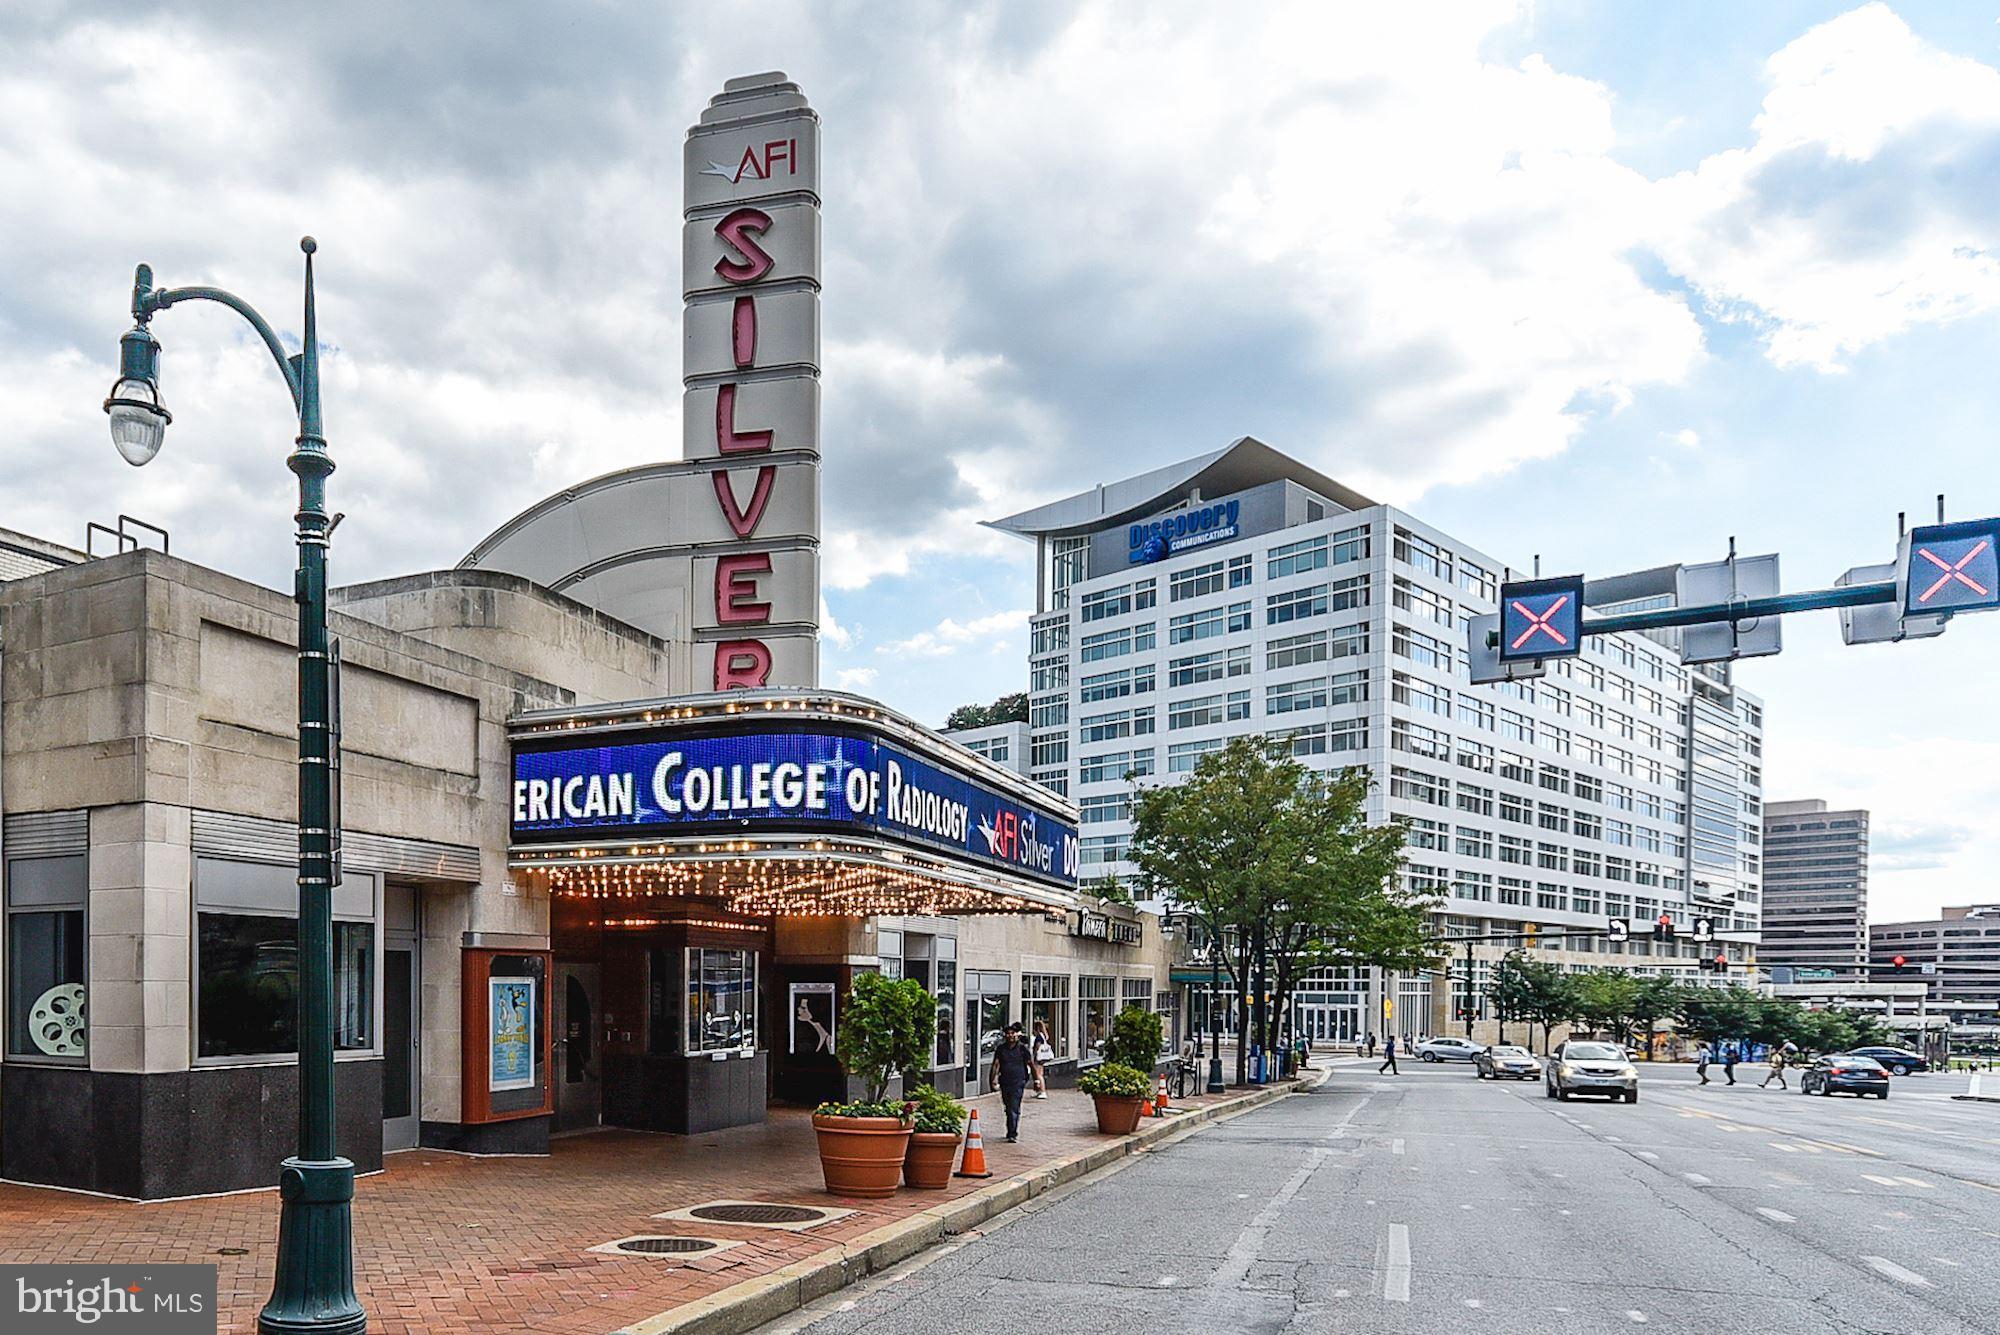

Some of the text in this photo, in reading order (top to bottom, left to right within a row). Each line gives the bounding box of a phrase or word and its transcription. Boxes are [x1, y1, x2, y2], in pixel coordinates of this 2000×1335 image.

[733, 138, 796, 184] AFI
[712, 207, 777, 691] SILVER
[1171, 526, 1235, 551] COMMUNICATIONS
[514, 772, 633, 821] ERICAN
[846, 767, 880, 816] OF
[992, 808, 1054, 873] AFI Silver
